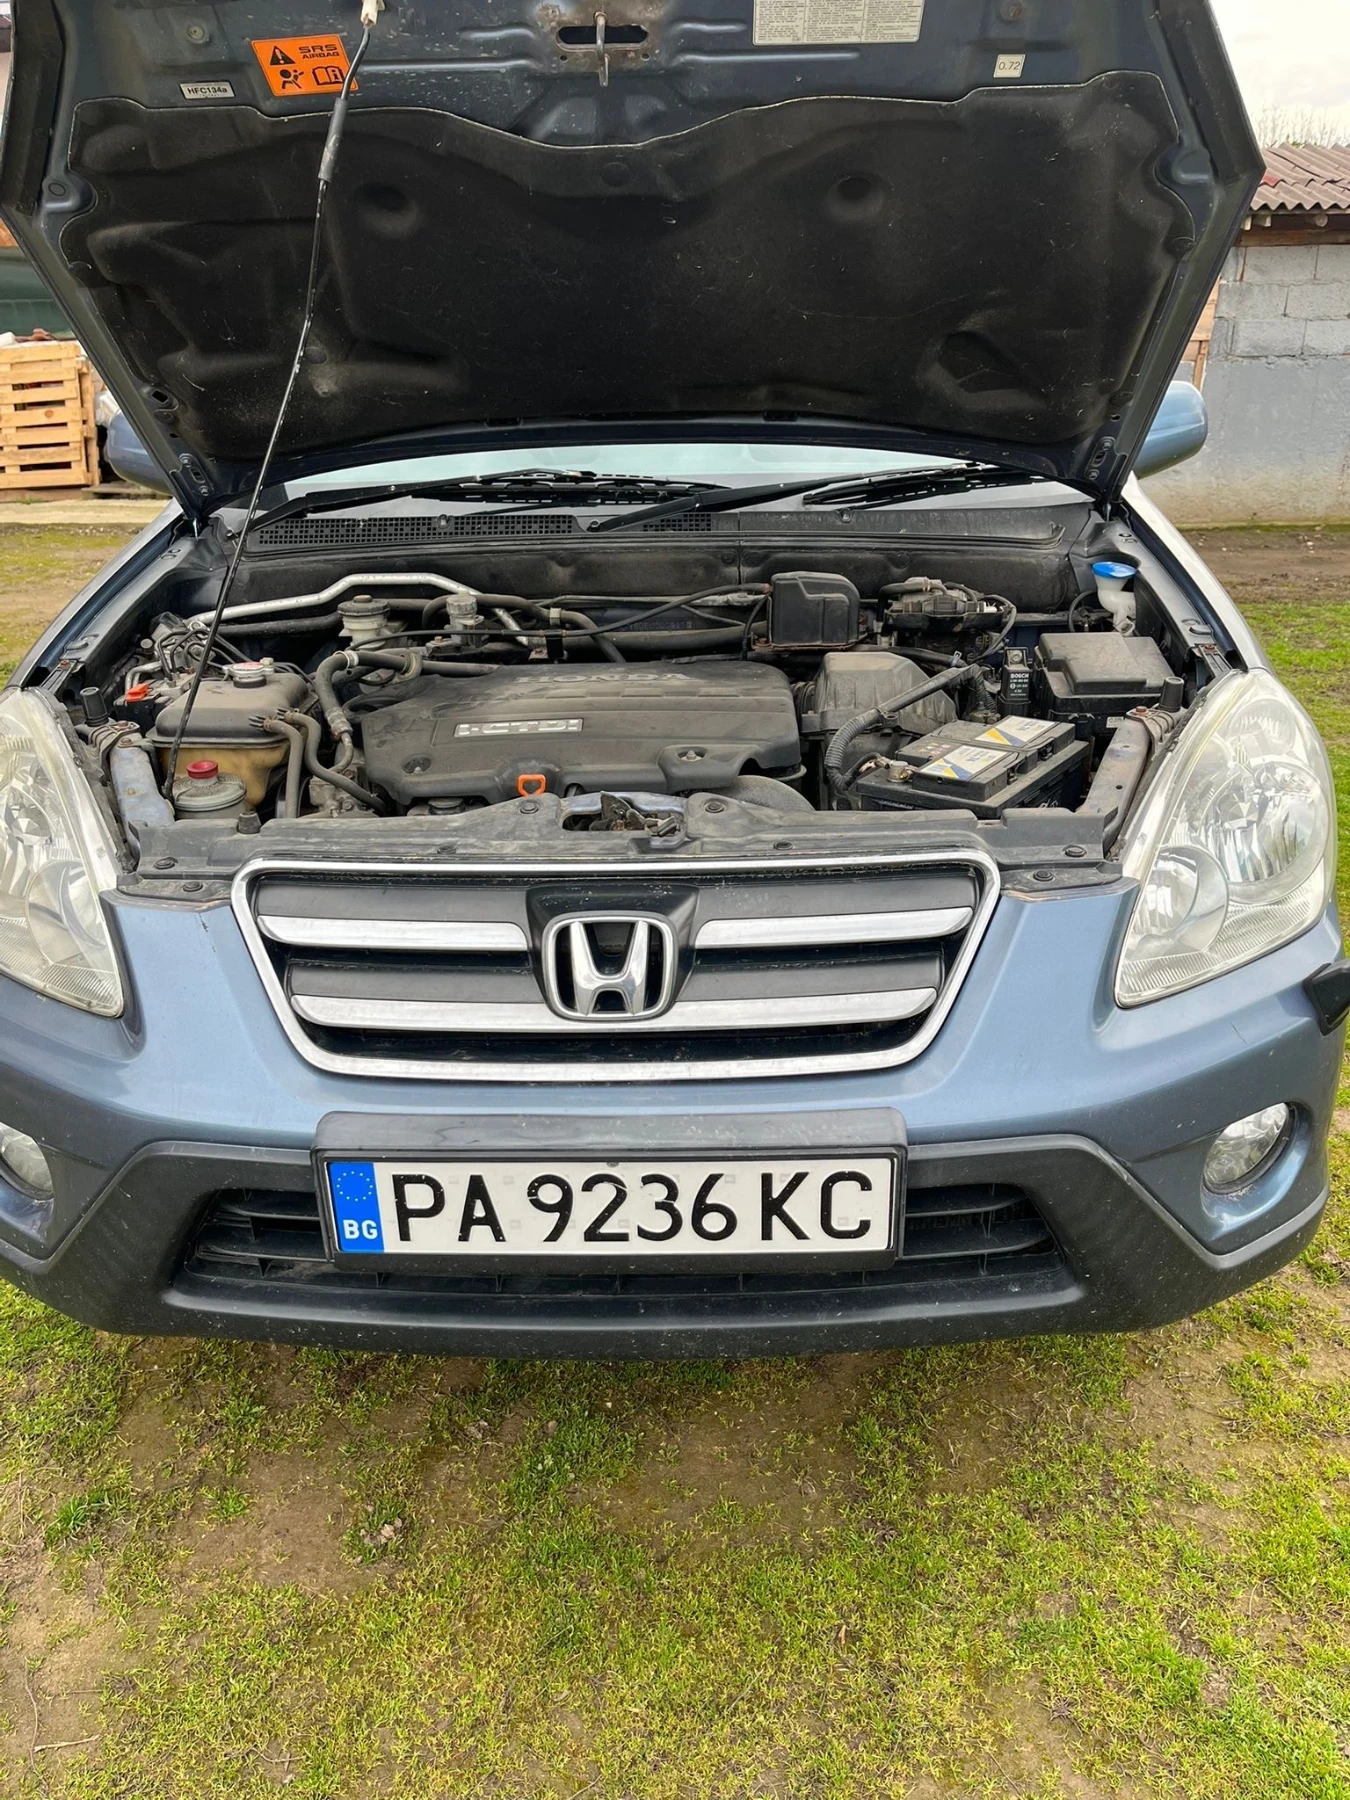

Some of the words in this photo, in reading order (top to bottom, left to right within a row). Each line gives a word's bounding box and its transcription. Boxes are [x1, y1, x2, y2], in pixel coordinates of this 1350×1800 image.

[298, 44, 337, 54] SRS
[302, 51, 339, 60] AIRBAG
[998, 61, 1020, 71] 0.72
[187, 86, 228, 95] HFC134a
[514, 673, 697, 684] HONDA
[392, 1173, 507, 1242] PA
[527, 1173, 738, 1242] 9236
[760, 1170, 873, 1241] KC
[343, 1219, 378, 1240] BG
